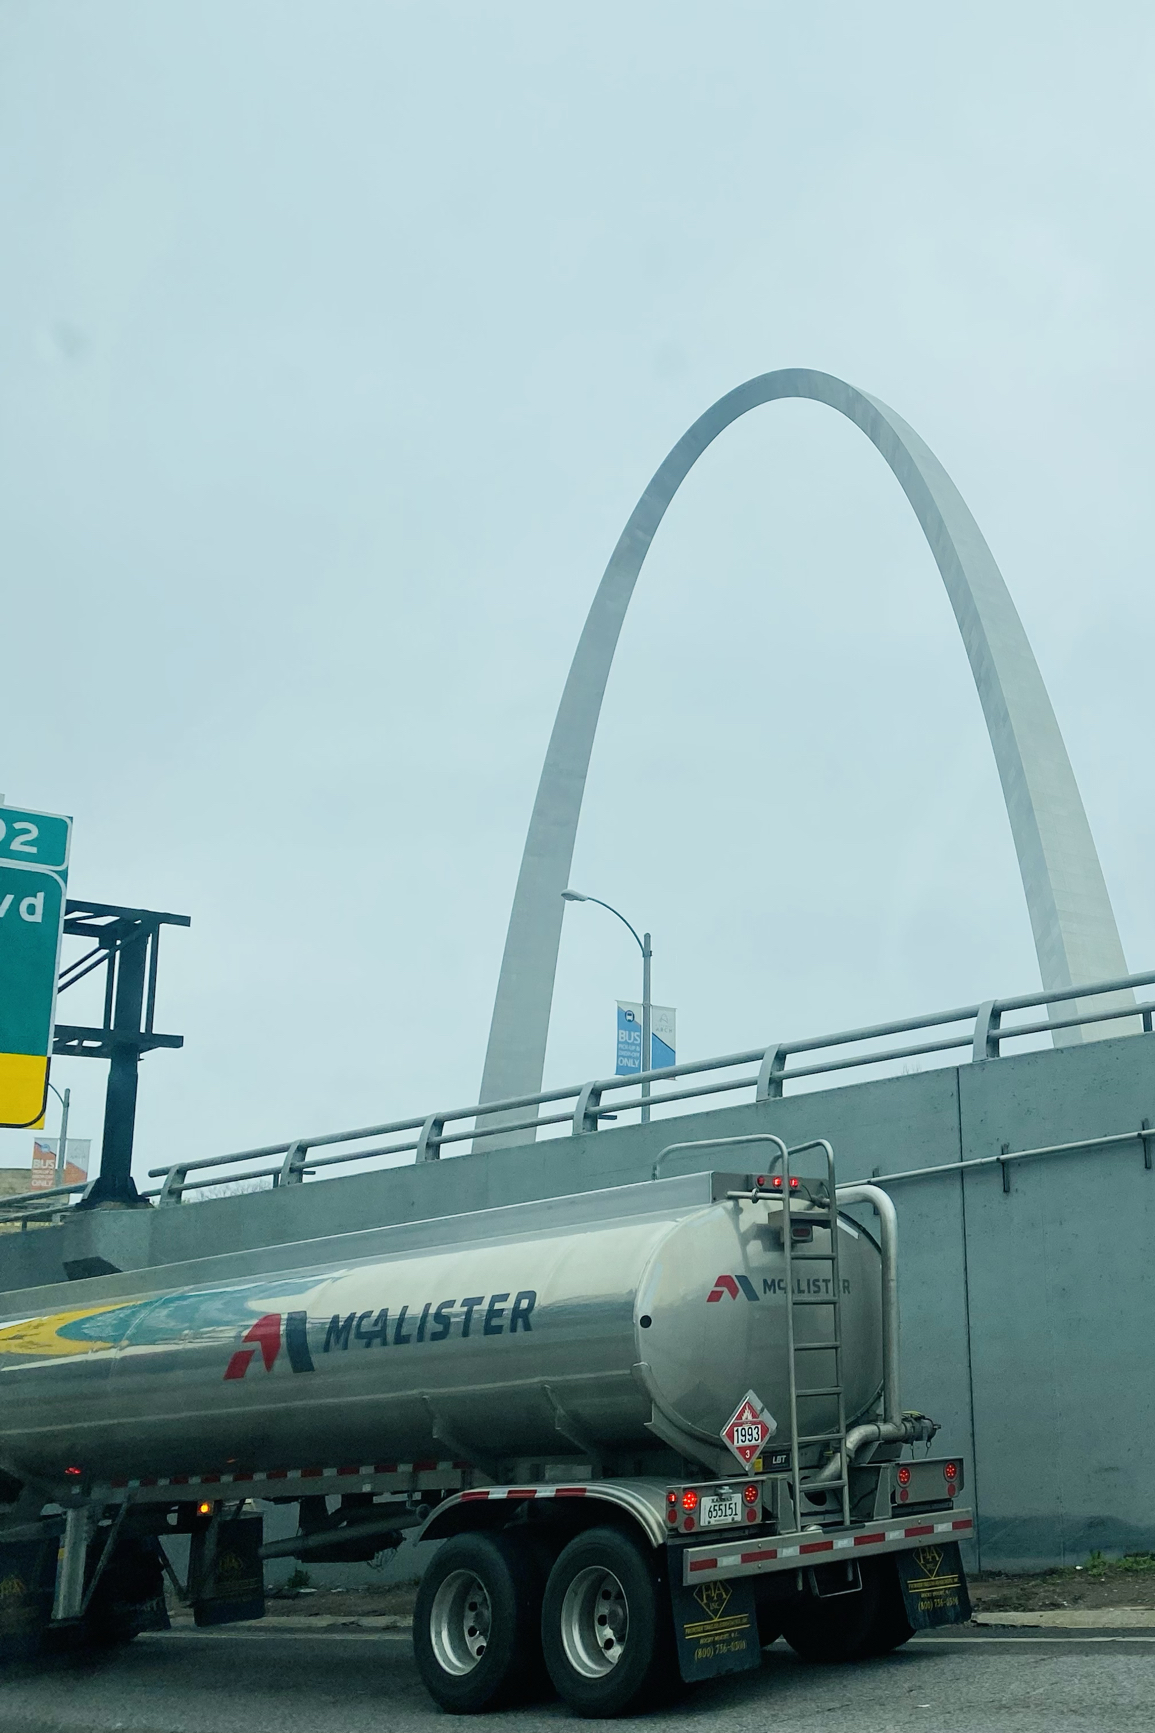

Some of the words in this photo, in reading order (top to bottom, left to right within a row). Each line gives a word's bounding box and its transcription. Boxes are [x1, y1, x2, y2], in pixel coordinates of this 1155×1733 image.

[0, 817, 39, 854] 2
[618, 1029, 640, 1044] BUS
[618, 1057, 640, 1067] ONLY
[33, 1159, 55, 1169] BUS
[735, 1426, 760, 1444] 1993
[745, 1449, 750, 1459] 3
[772, 1455, 787, 1464] LBT
[708, 1502, 738, 1519] 655151
[695, 1646, 714, 1662] (800)
